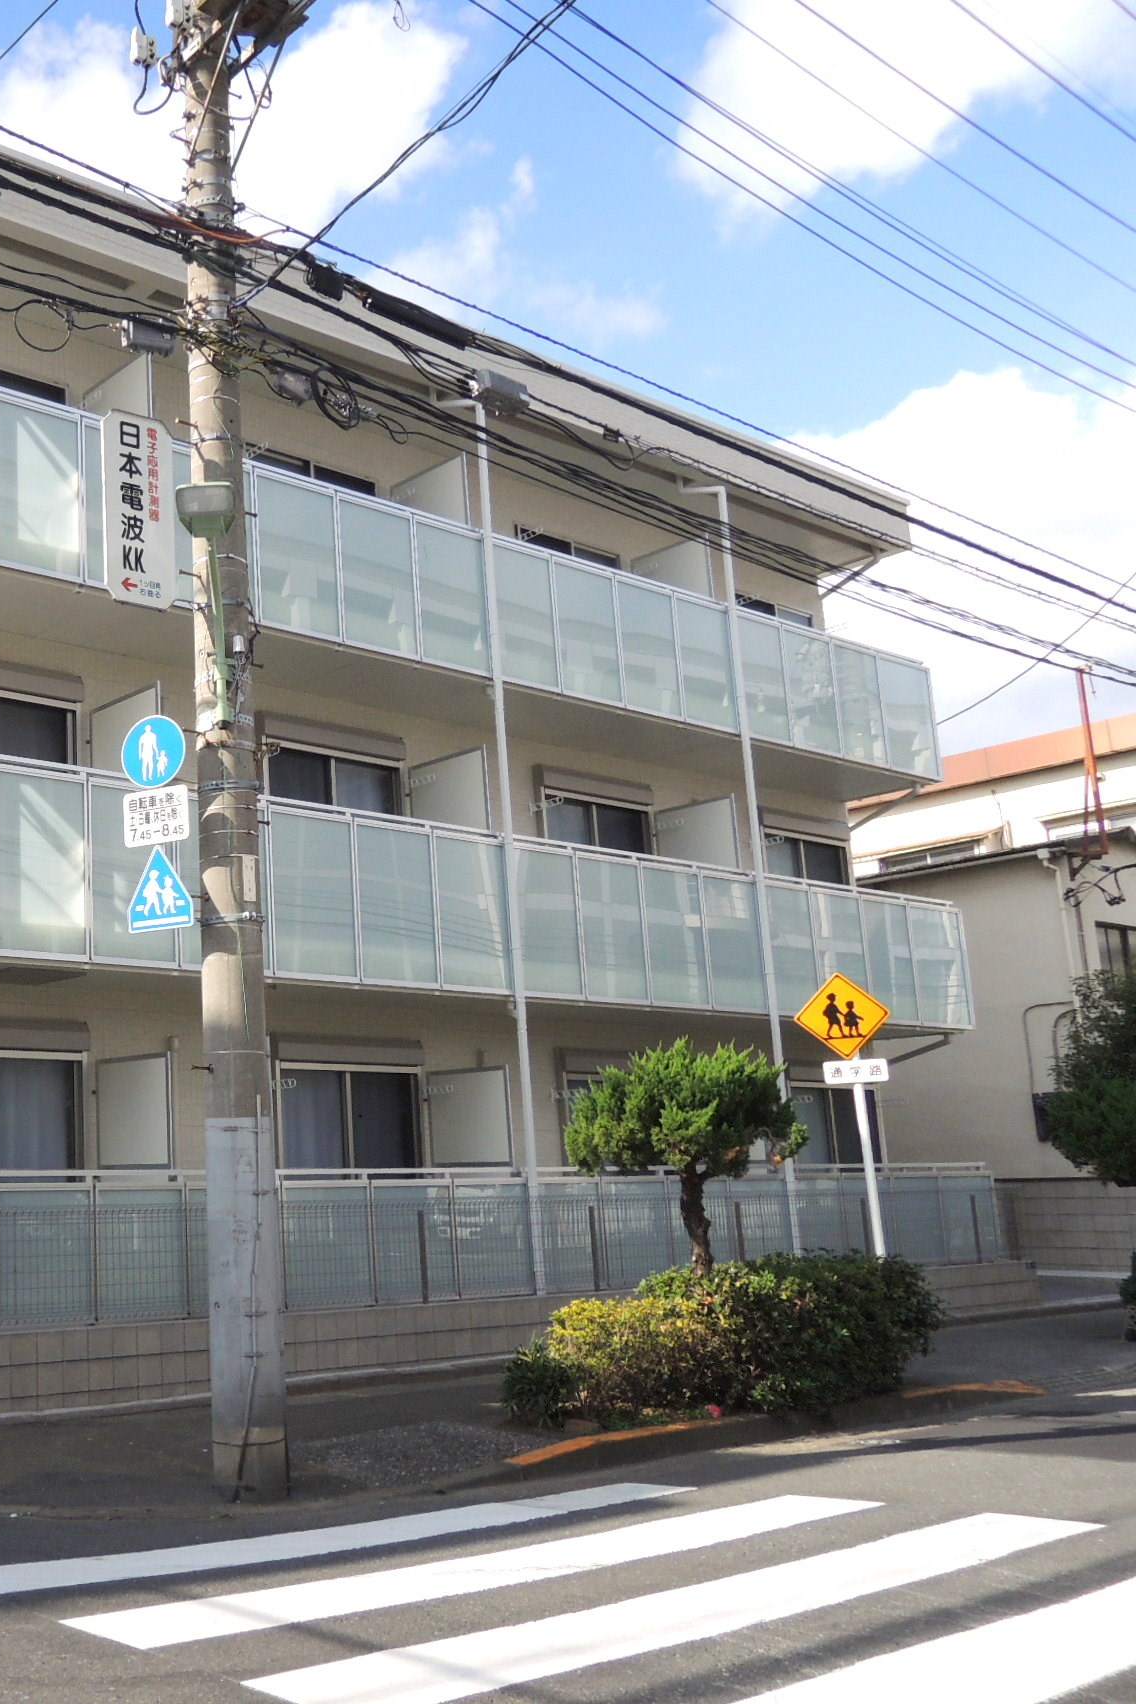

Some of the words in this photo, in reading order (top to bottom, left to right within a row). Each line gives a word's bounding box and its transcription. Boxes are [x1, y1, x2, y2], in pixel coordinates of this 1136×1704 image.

[118, 420, 146, 574] 日本電波KK
[128, 792, 182, 812] 自転車を除く
[830, 1064, 883, 1079] 通学路
